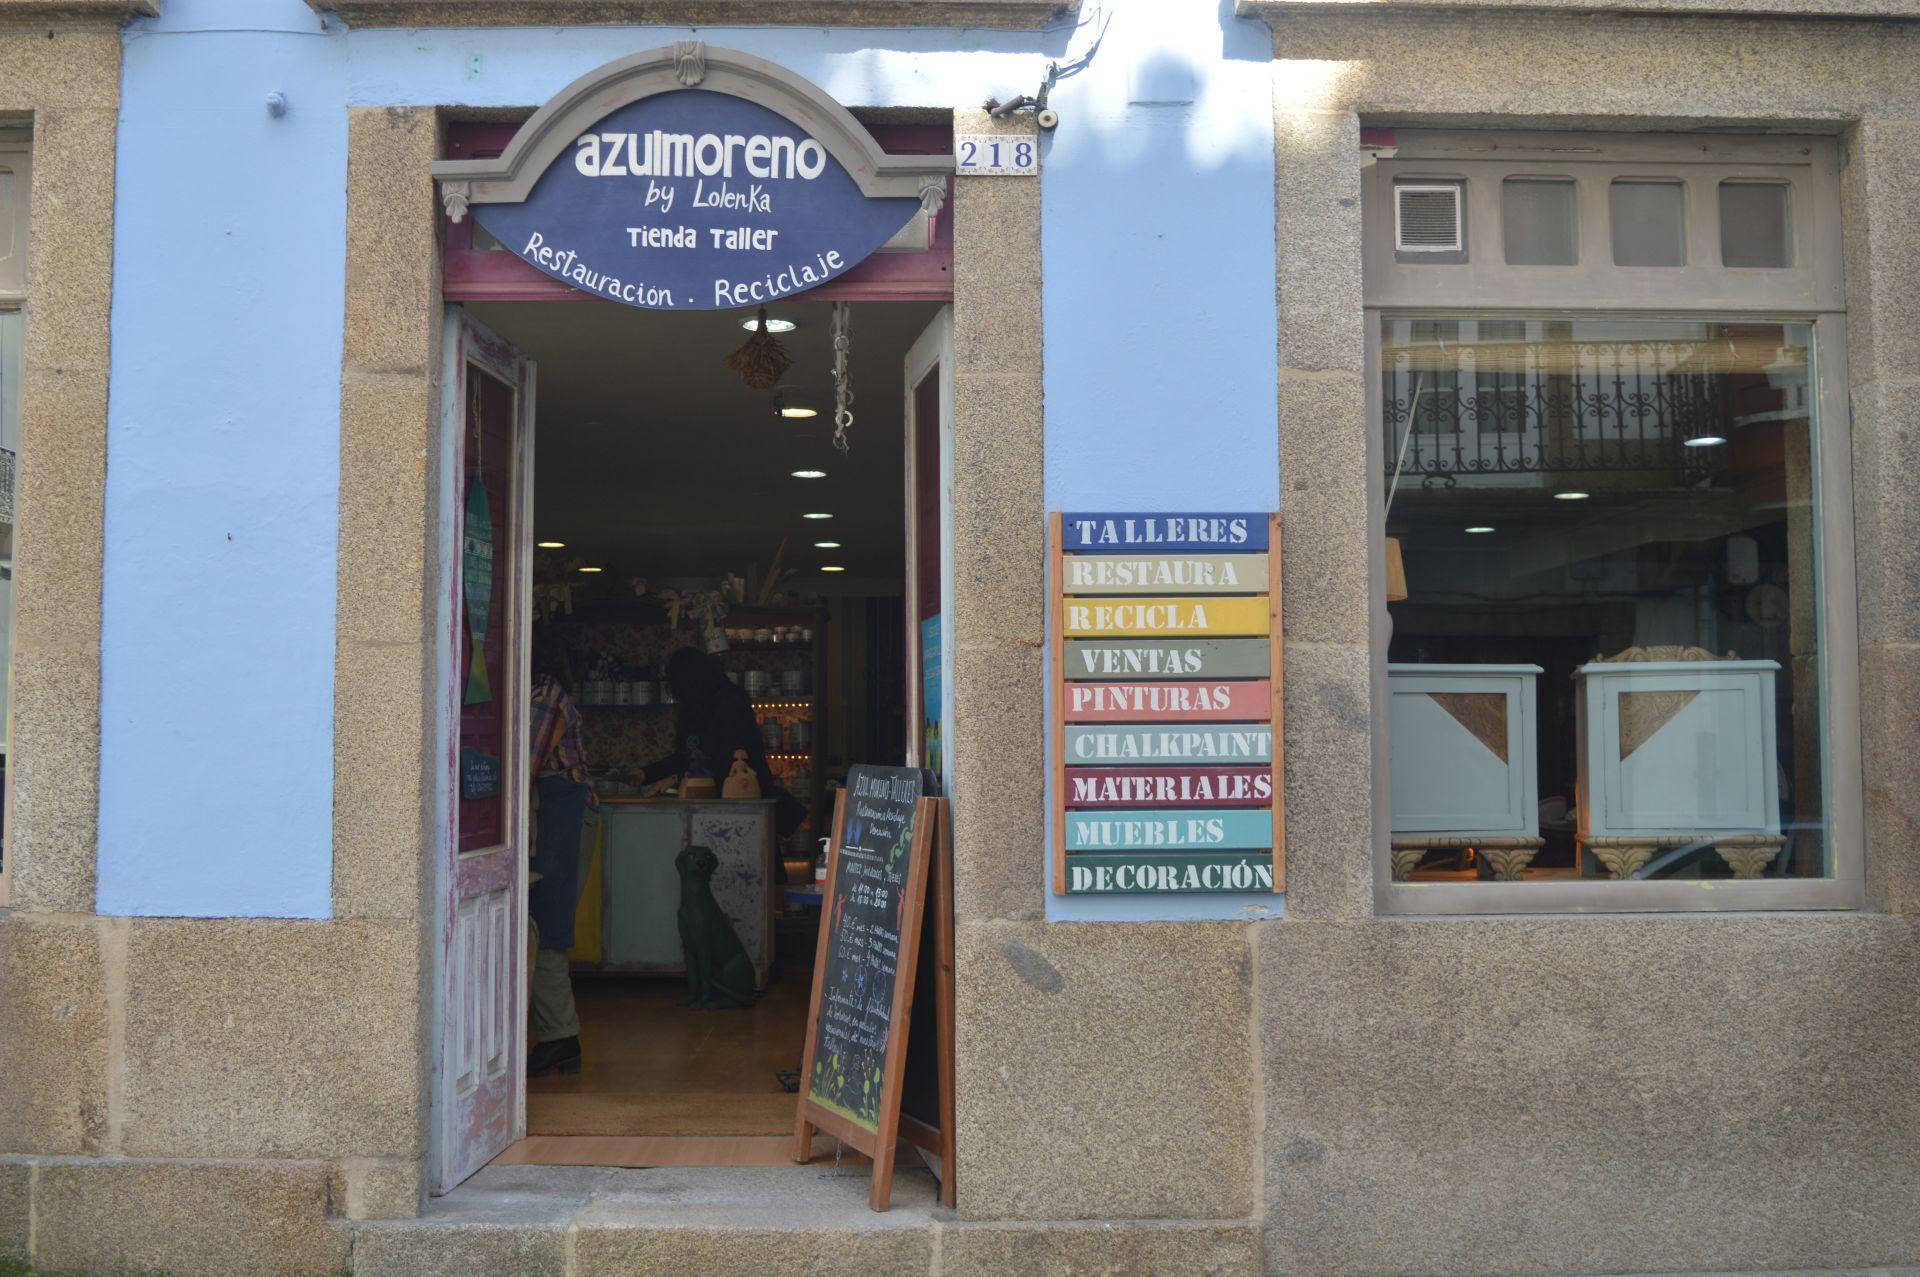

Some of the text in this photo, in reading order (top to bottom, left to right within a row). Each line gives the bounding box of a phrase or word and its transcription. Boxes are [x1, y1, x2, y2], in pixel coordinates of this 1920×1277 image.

[575, 130, 827, 180] azulmoreno
[961, 142, 1032, 168] 218
[645, 179, 675, 213] by
[626, 225, 779, 250] Tienda Taller
[523, 231, 845, 307] Restauración Reciclaje
[1076, 518, 1247, 545] TALLERES
[1072, 560, 1240, 586] RESTAURA
[1069, 604, 1209, 630] RECICLA
[1081, 648, 1202, 673] VENTAS
[1071, 686, 1231, 711] PINTURAS
[1075, 732, 1271, 759] CHALKPAINT
[1072, 774, 1271, 802] MATERIALES
[1075, 818, 1224, 846] MUEBLES
[1071, 859, 1273, 891] DECORACIÓN
